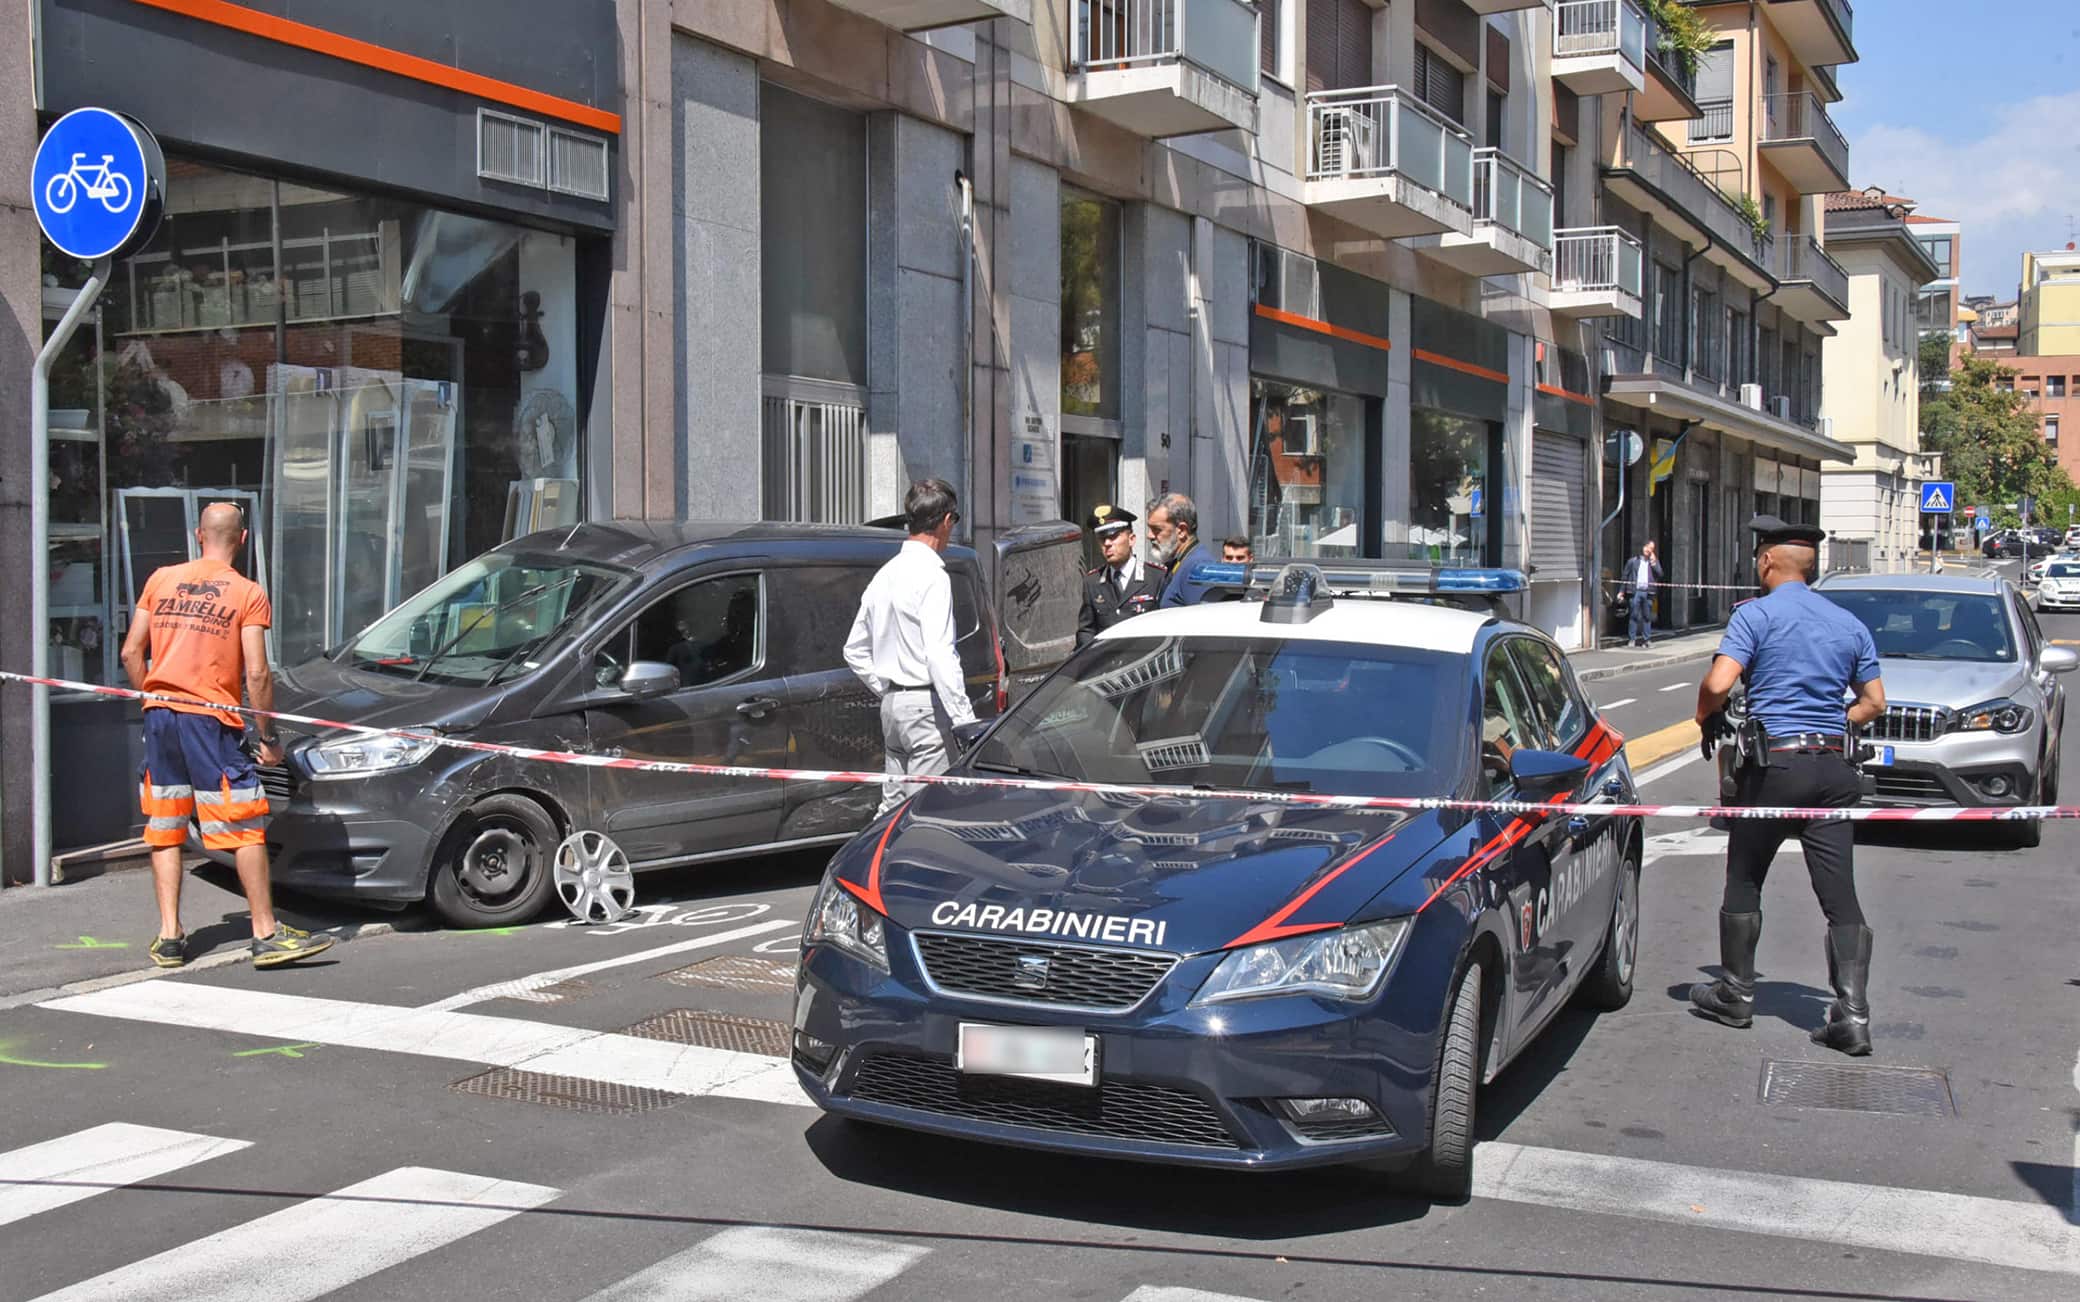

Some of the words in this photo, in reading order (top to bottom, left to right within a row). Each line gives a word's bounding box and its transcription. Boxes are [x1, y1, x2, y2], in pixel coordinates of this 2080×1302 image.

[202, 615, 231, 628] DINO
[1537, 824, 1612, 938] CARABINIERI
[931, 901, 1167, 946] CARABINIERI
